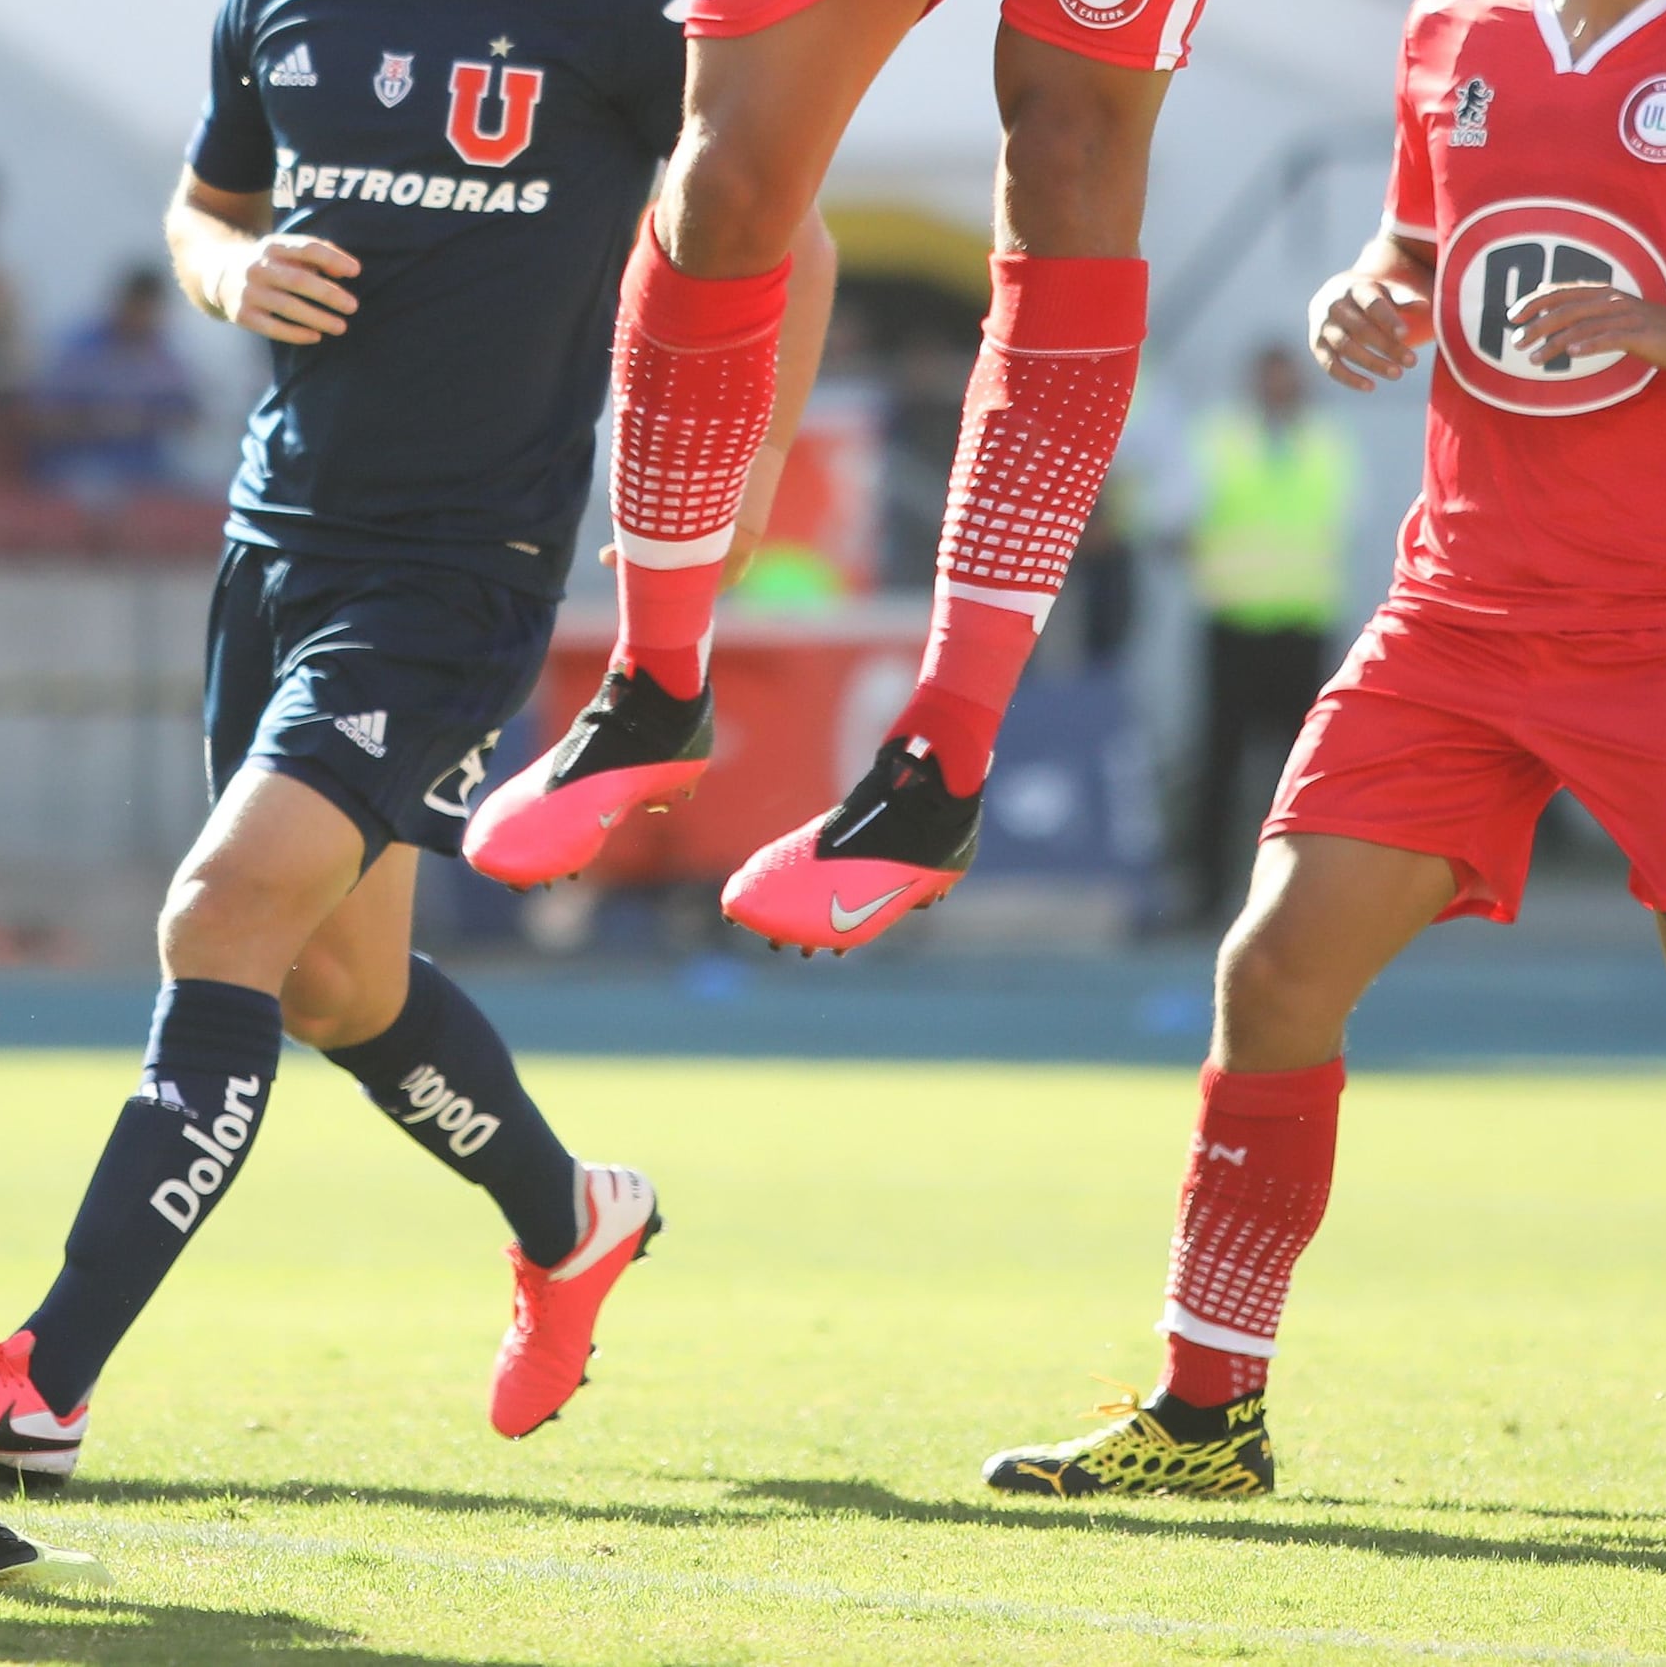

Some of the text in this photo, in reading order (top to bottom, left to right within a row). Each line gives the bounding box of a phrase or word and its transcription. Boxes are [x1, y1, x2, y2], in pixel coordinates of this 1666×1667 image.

[446, 61, 544, 168] U
[295, 164, 550, 214] PETROBRAS
[333, 717, 388, 760] adidas
